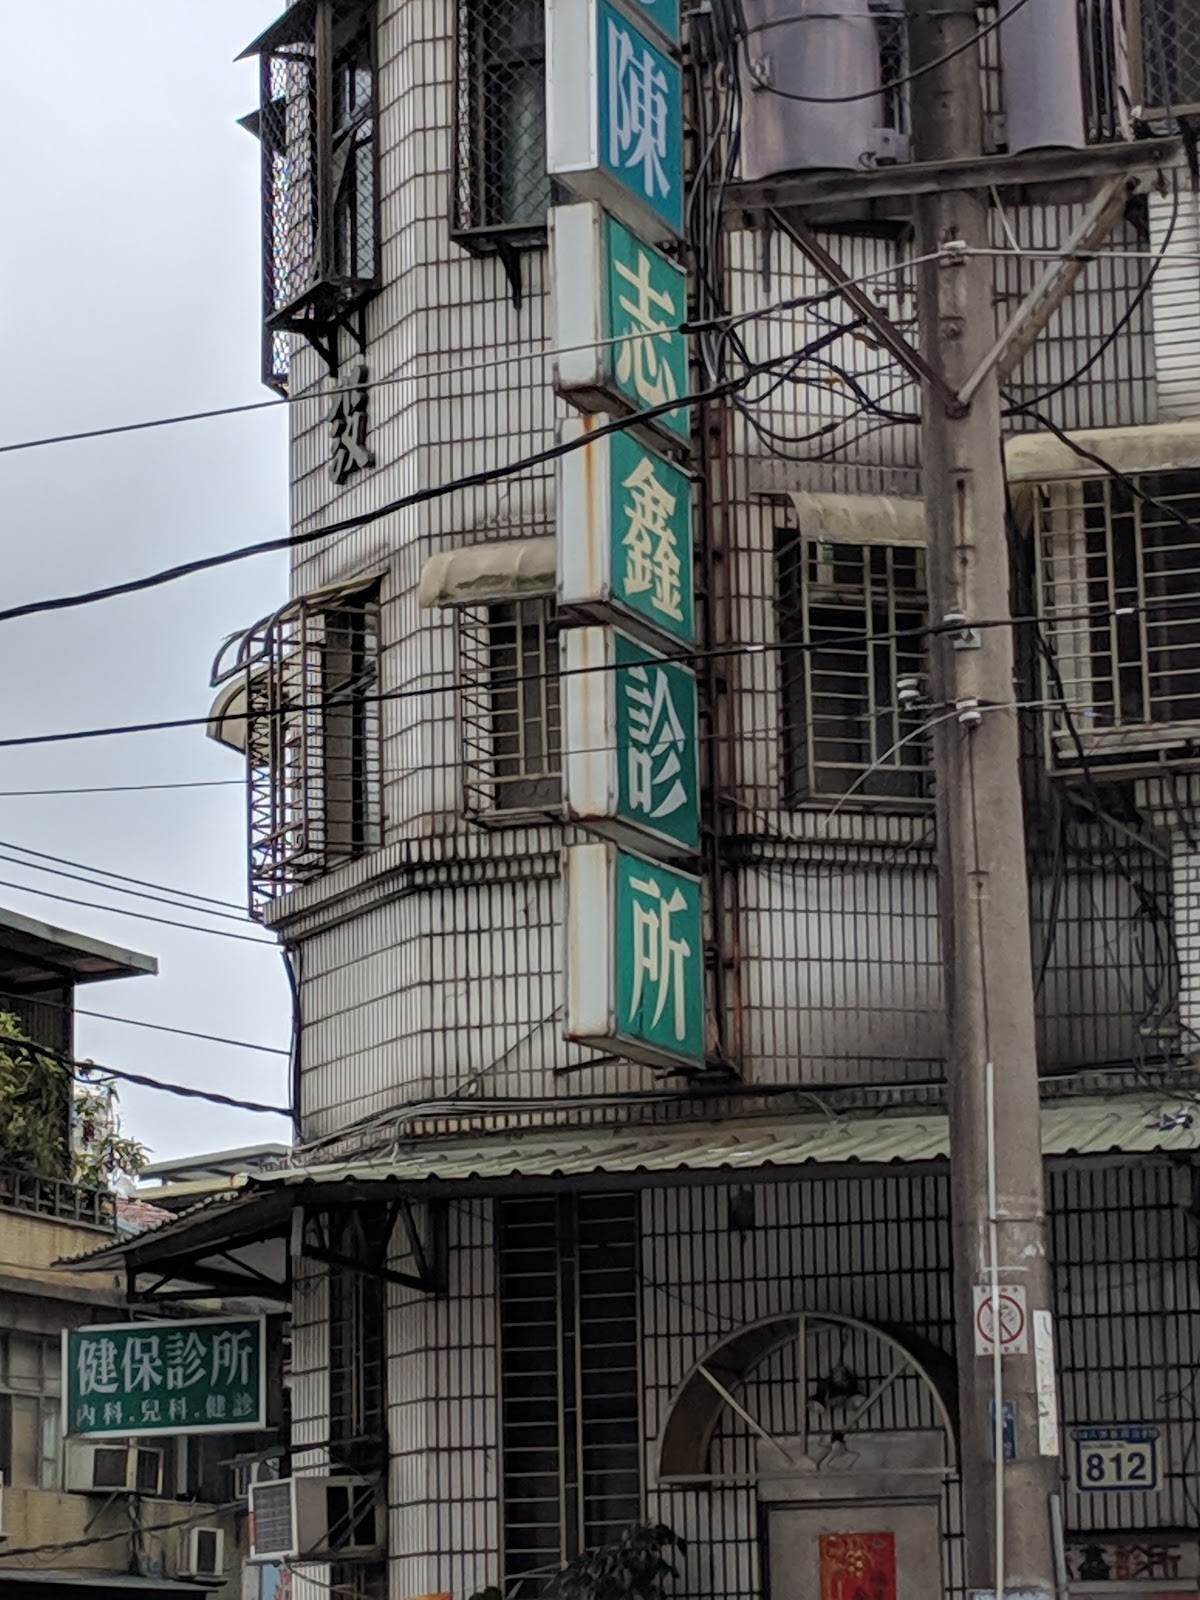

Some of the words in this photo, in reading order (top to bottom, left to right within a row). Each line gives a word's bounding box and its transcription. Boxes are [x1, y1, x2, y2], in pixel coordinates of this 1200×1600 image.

[77, 1328, 254, 1396] 健保診所
[1087, 1453, 1146, 1481] 812
